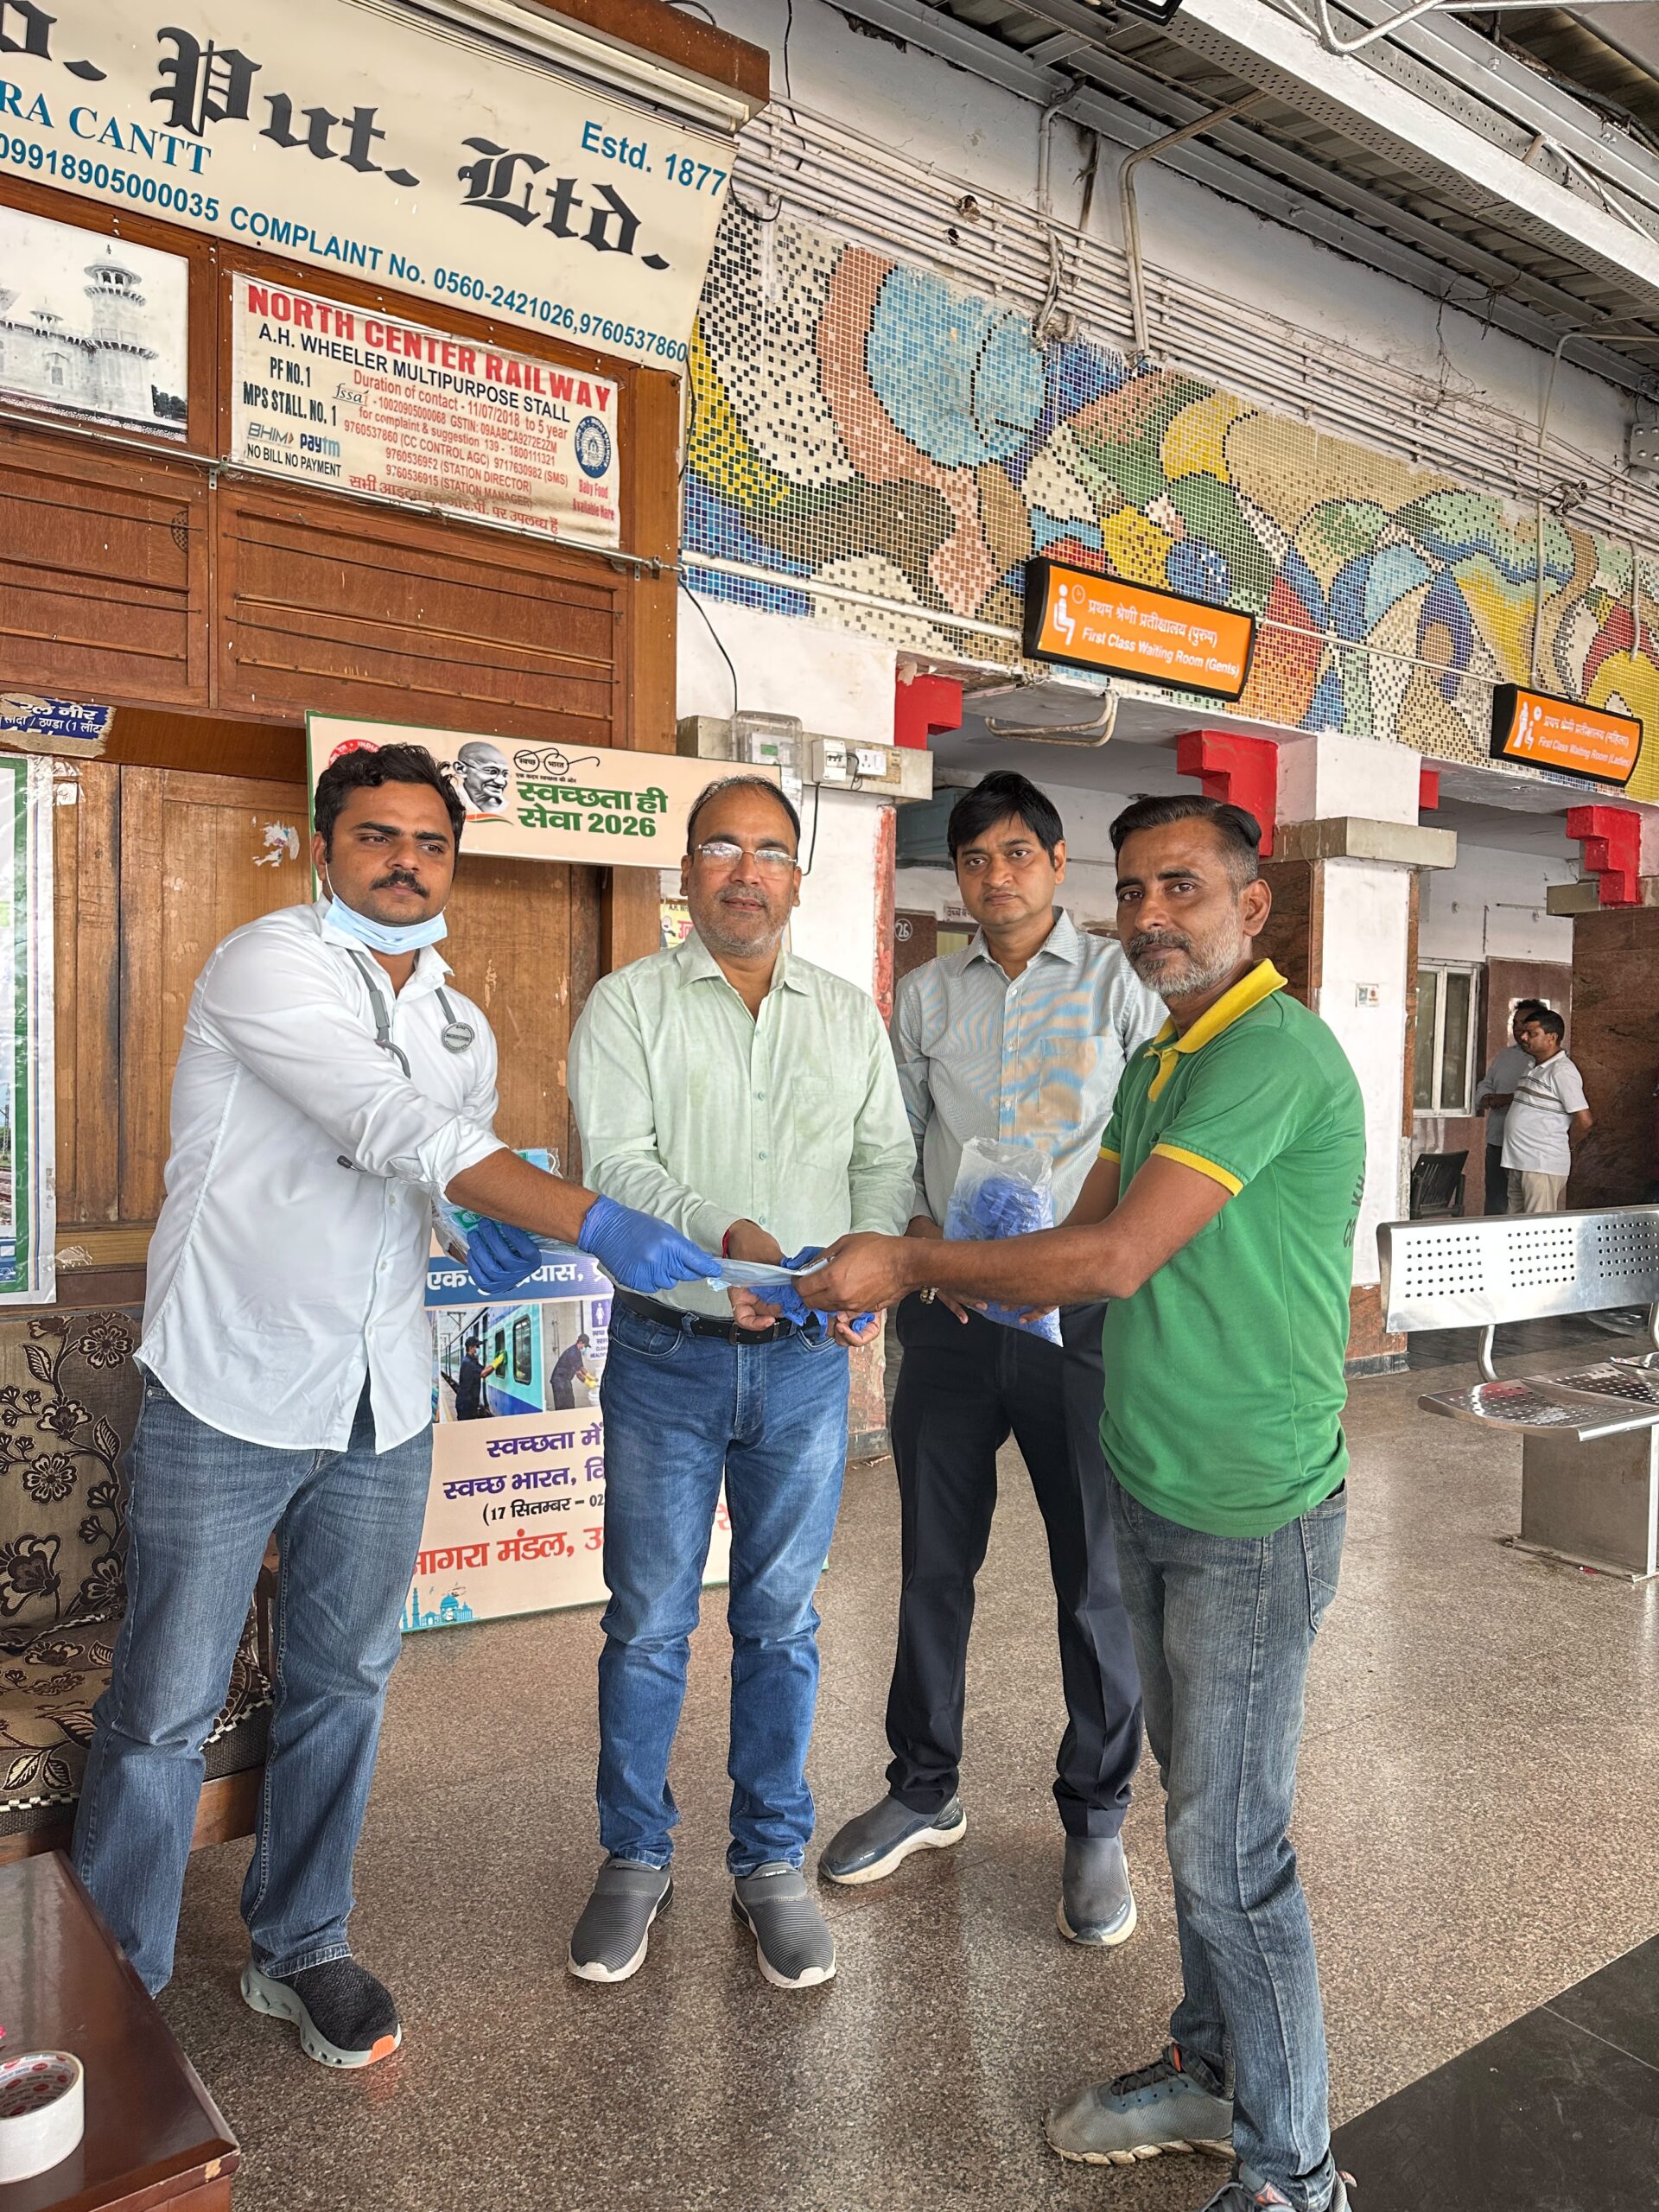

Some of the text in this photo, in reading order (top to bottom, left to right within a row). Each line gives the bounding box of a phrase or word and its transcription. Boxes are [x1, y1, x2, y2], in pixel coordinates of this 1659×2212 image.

[69, 106, 212, 175] CANTT
[582, 121, 728, 196] Estd. 1877
[457, 137, 670, 270] Ltd.
[231, 207, 383, 270] COMPLAINT
[389, 253, 425, 284] No.
[434, 268, 688, 362] 0560-2421026,9760537860
[248, 285, 610, 412] NORTH CENTER RAILWAY
[259, 322, 570, 423] A.H. WHEELER MULTIPURPOSE STALL
[270, 356, 283, 379] PF
[243, 381, 268, 409] MPS
[309, 399, 327, 424] NO.
[354, 370, 401, 395] Duration
[405, 385, 416, 398] of
[419, 392, 458, 410] contact
[467, 401, 519, 427] 11/07/2018
[525, 416, 535, 430] to
[538, 419, 544, 433] 5
[546, 423, 568, 440] year
[300, 433, 340, 458] paytm
[359, 406, 372, 419] for
[375, 412, 420, 432] complaint
[431, 428, 480, 447] suggestion
[485, 440, 499, 454] 139
[247, 443, 341, 477] NO BILL NO PAYMENT
[344, 420, 397, 443] 9760537860
[400, 433, 417, 448] (CC
[420, 438, 464, 461] CONTROL
[544, 470, 568, 486] (SMS)
[349, 474, 377, 492] सभी
[441, 460, 481, 480] (STATION
[484, 471, 531, 495] DIRECTOR)
[441, 476, 483, 497] (STATION
[1088, 600, 1113, 619] प्रथम
[1082, 627, 1240, 678] First Class Waiting Room (Gents)
[58, 704, 99, 720] नीर
[516, 781, 668, 813] स्वच्छता ही
[517, 803, 656, 837] सेवा 2026
[896, 923, 909, 937] 26
[486, 1431, 575, 1458] स्वच्छता
[442, 1475, 506, 1500] स्वच्छ
[512, 1467, 576, 1490] भारत,
[482, 1503, 506, 1526] (17
[511, 1498, 571, 1517] सितम्बर
[497, 1529, 575, 1561] मंडल,
